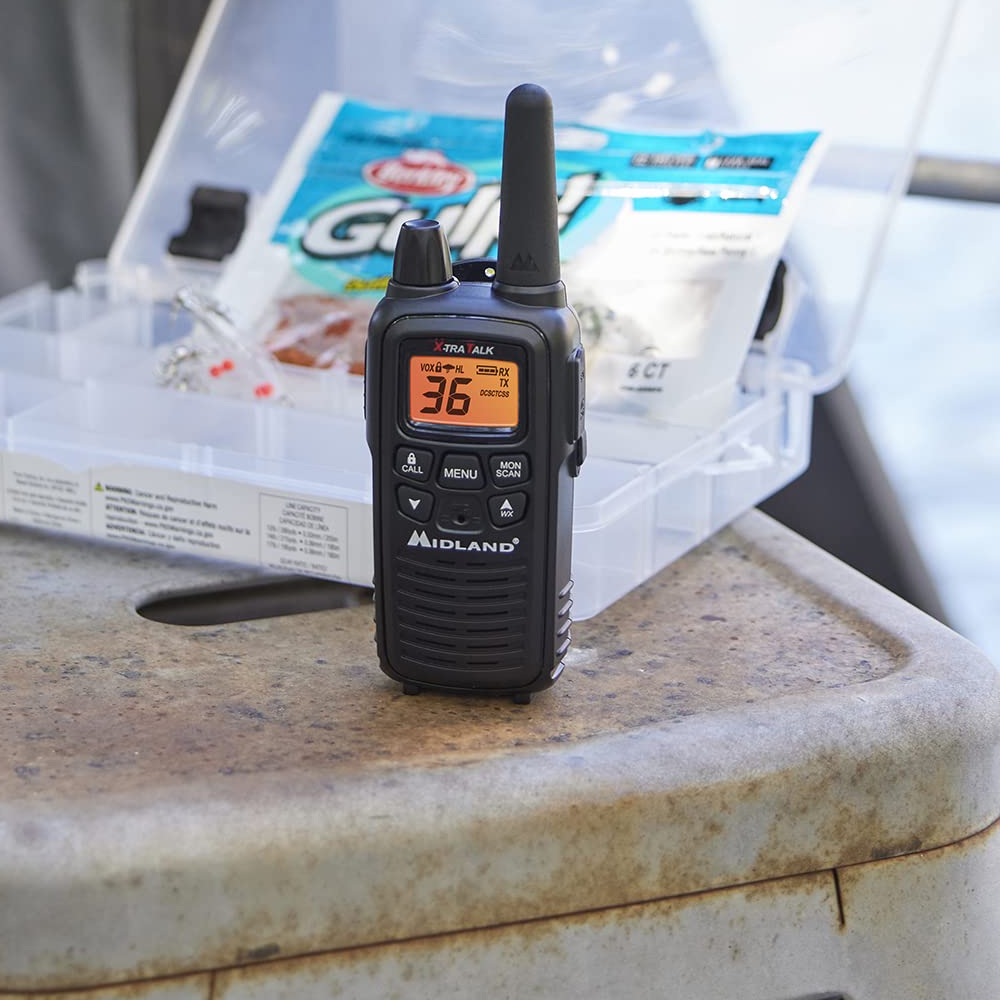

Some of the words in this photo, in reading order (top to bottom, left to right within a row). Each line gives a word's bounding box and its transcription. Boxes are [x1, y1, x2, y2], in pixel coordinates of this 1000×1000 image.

[466, 343, 495, 355] TALK
[420, 363, 435, 373] VOX
[499, 367, 510, 377] RX
[499, 378, 510, 388] TX
[420, 375, 473, 416] 36
[402, 465, 424, 475] CALL
[500, 461, 522, 470] MON
[444, 468, 478, 480] MENU
[496, 469, 522, 478] SCAN
[500, 510, 514, 518] WX
[407, 529, 515, 553] MIDLAND
